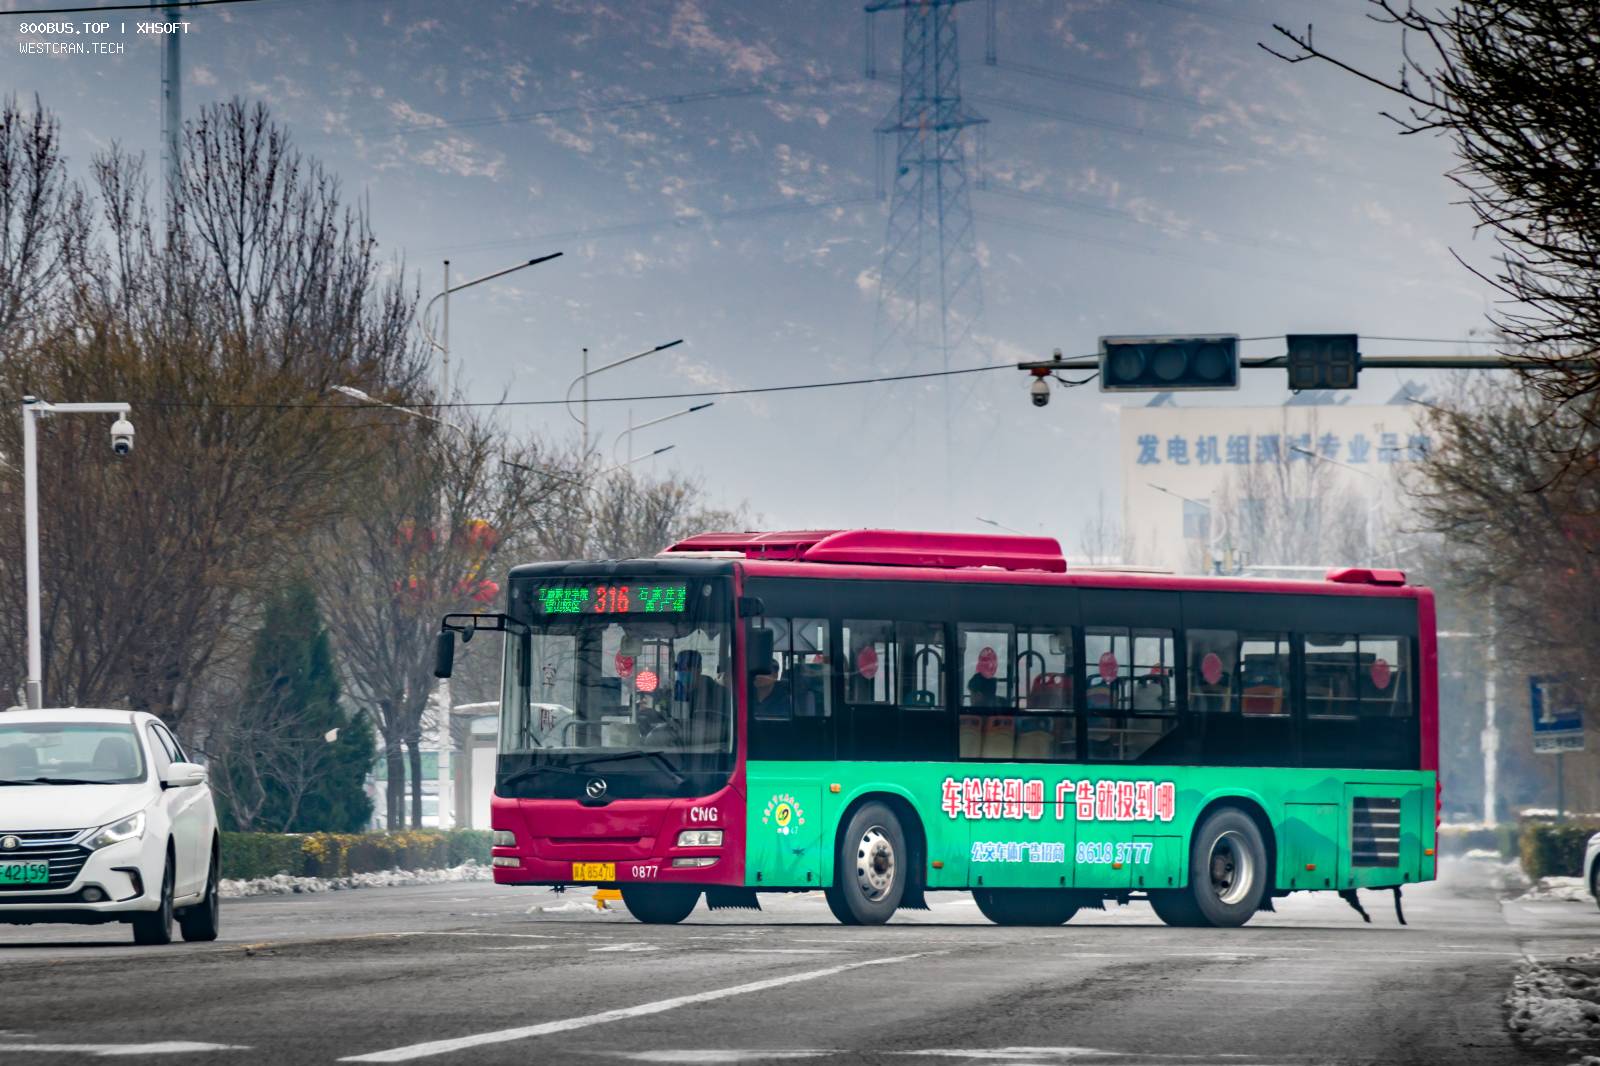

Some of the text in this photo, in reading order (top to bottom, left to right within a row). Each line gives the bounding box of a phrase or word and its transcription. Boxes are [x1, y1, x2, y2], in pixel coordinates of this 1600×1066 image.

[594, 586, 630, 613] 316
[942, 778, 1175, 822] 车轮转到哪 广告就投到哪
[690, 807, 718, 822] CNG
[1076, 842, 1112, 864] 8618
[1115, 844, 1152, 864] 3777
[632, 865, 658, 879] 0877
